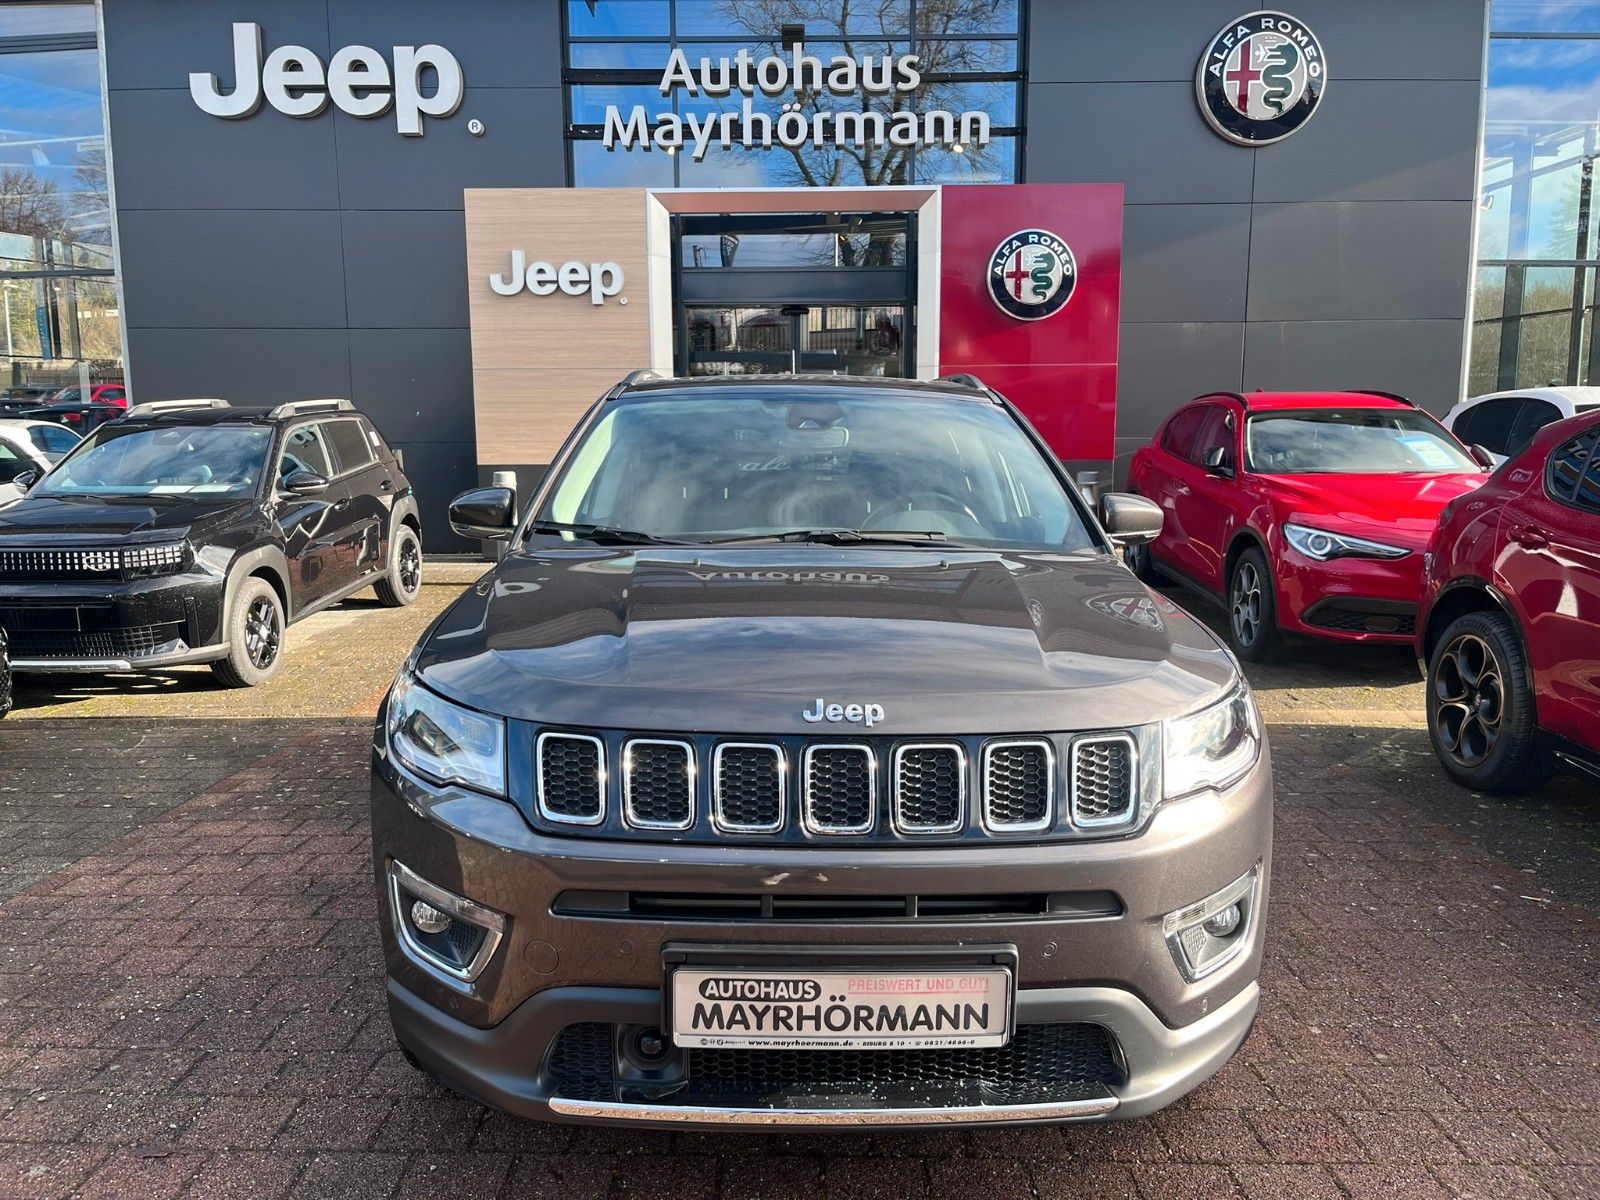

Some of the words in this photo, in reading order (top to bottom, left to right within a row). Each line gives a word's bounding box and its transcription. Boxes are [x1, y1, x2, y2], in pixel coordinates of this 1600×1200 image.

[1208, 25, 1251, 78] ALFA
[1261, 17, 1321, 78] ROMEO
[188, 22, 464, 136] Jeep
[659, 42, 921, 98] Autohaus
[602, 98, 991, 162] Mayrhörmann
[993, 239, 1022, 276] ALFA
[1028, 234, 1073, 276] ROMEO
[489, 249, 625, 306] Jeep
[802, 698, 885, 727] Jeep
[704, 979, 817, 999] AUTOHAUS
[848, 978, 922, 991] PREISWERT
[926, 978, 955, 990] UND
[958, 977, 989, 993] GUT!
[691, 994, 990, 1032] MAYRHÖRMANN
[748, 1038, 854, 1048] www.mayrhoermann.de
